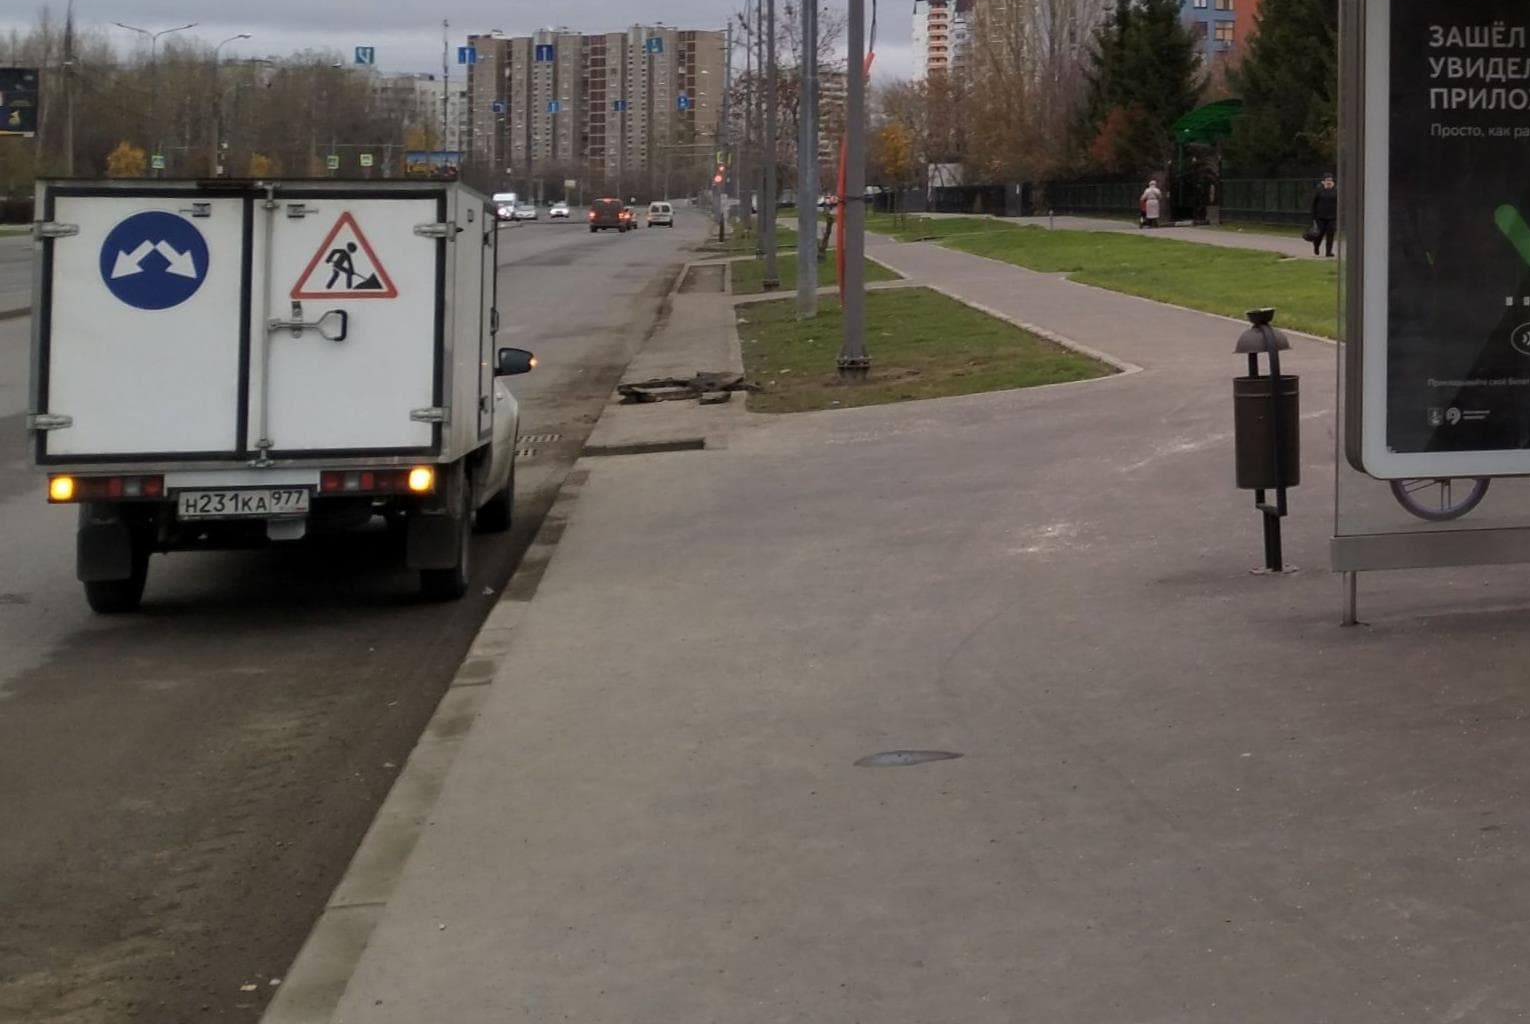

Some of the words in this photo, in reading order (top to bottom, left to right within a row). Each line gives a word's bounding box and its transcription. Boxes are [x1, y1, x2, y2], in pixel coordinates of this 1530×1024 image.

[1428, 20, 1526, 48] ЗАШЁЛ
[1430, 123, 1485, 139] Просто,
[1488, 126, 1511, 137] как
